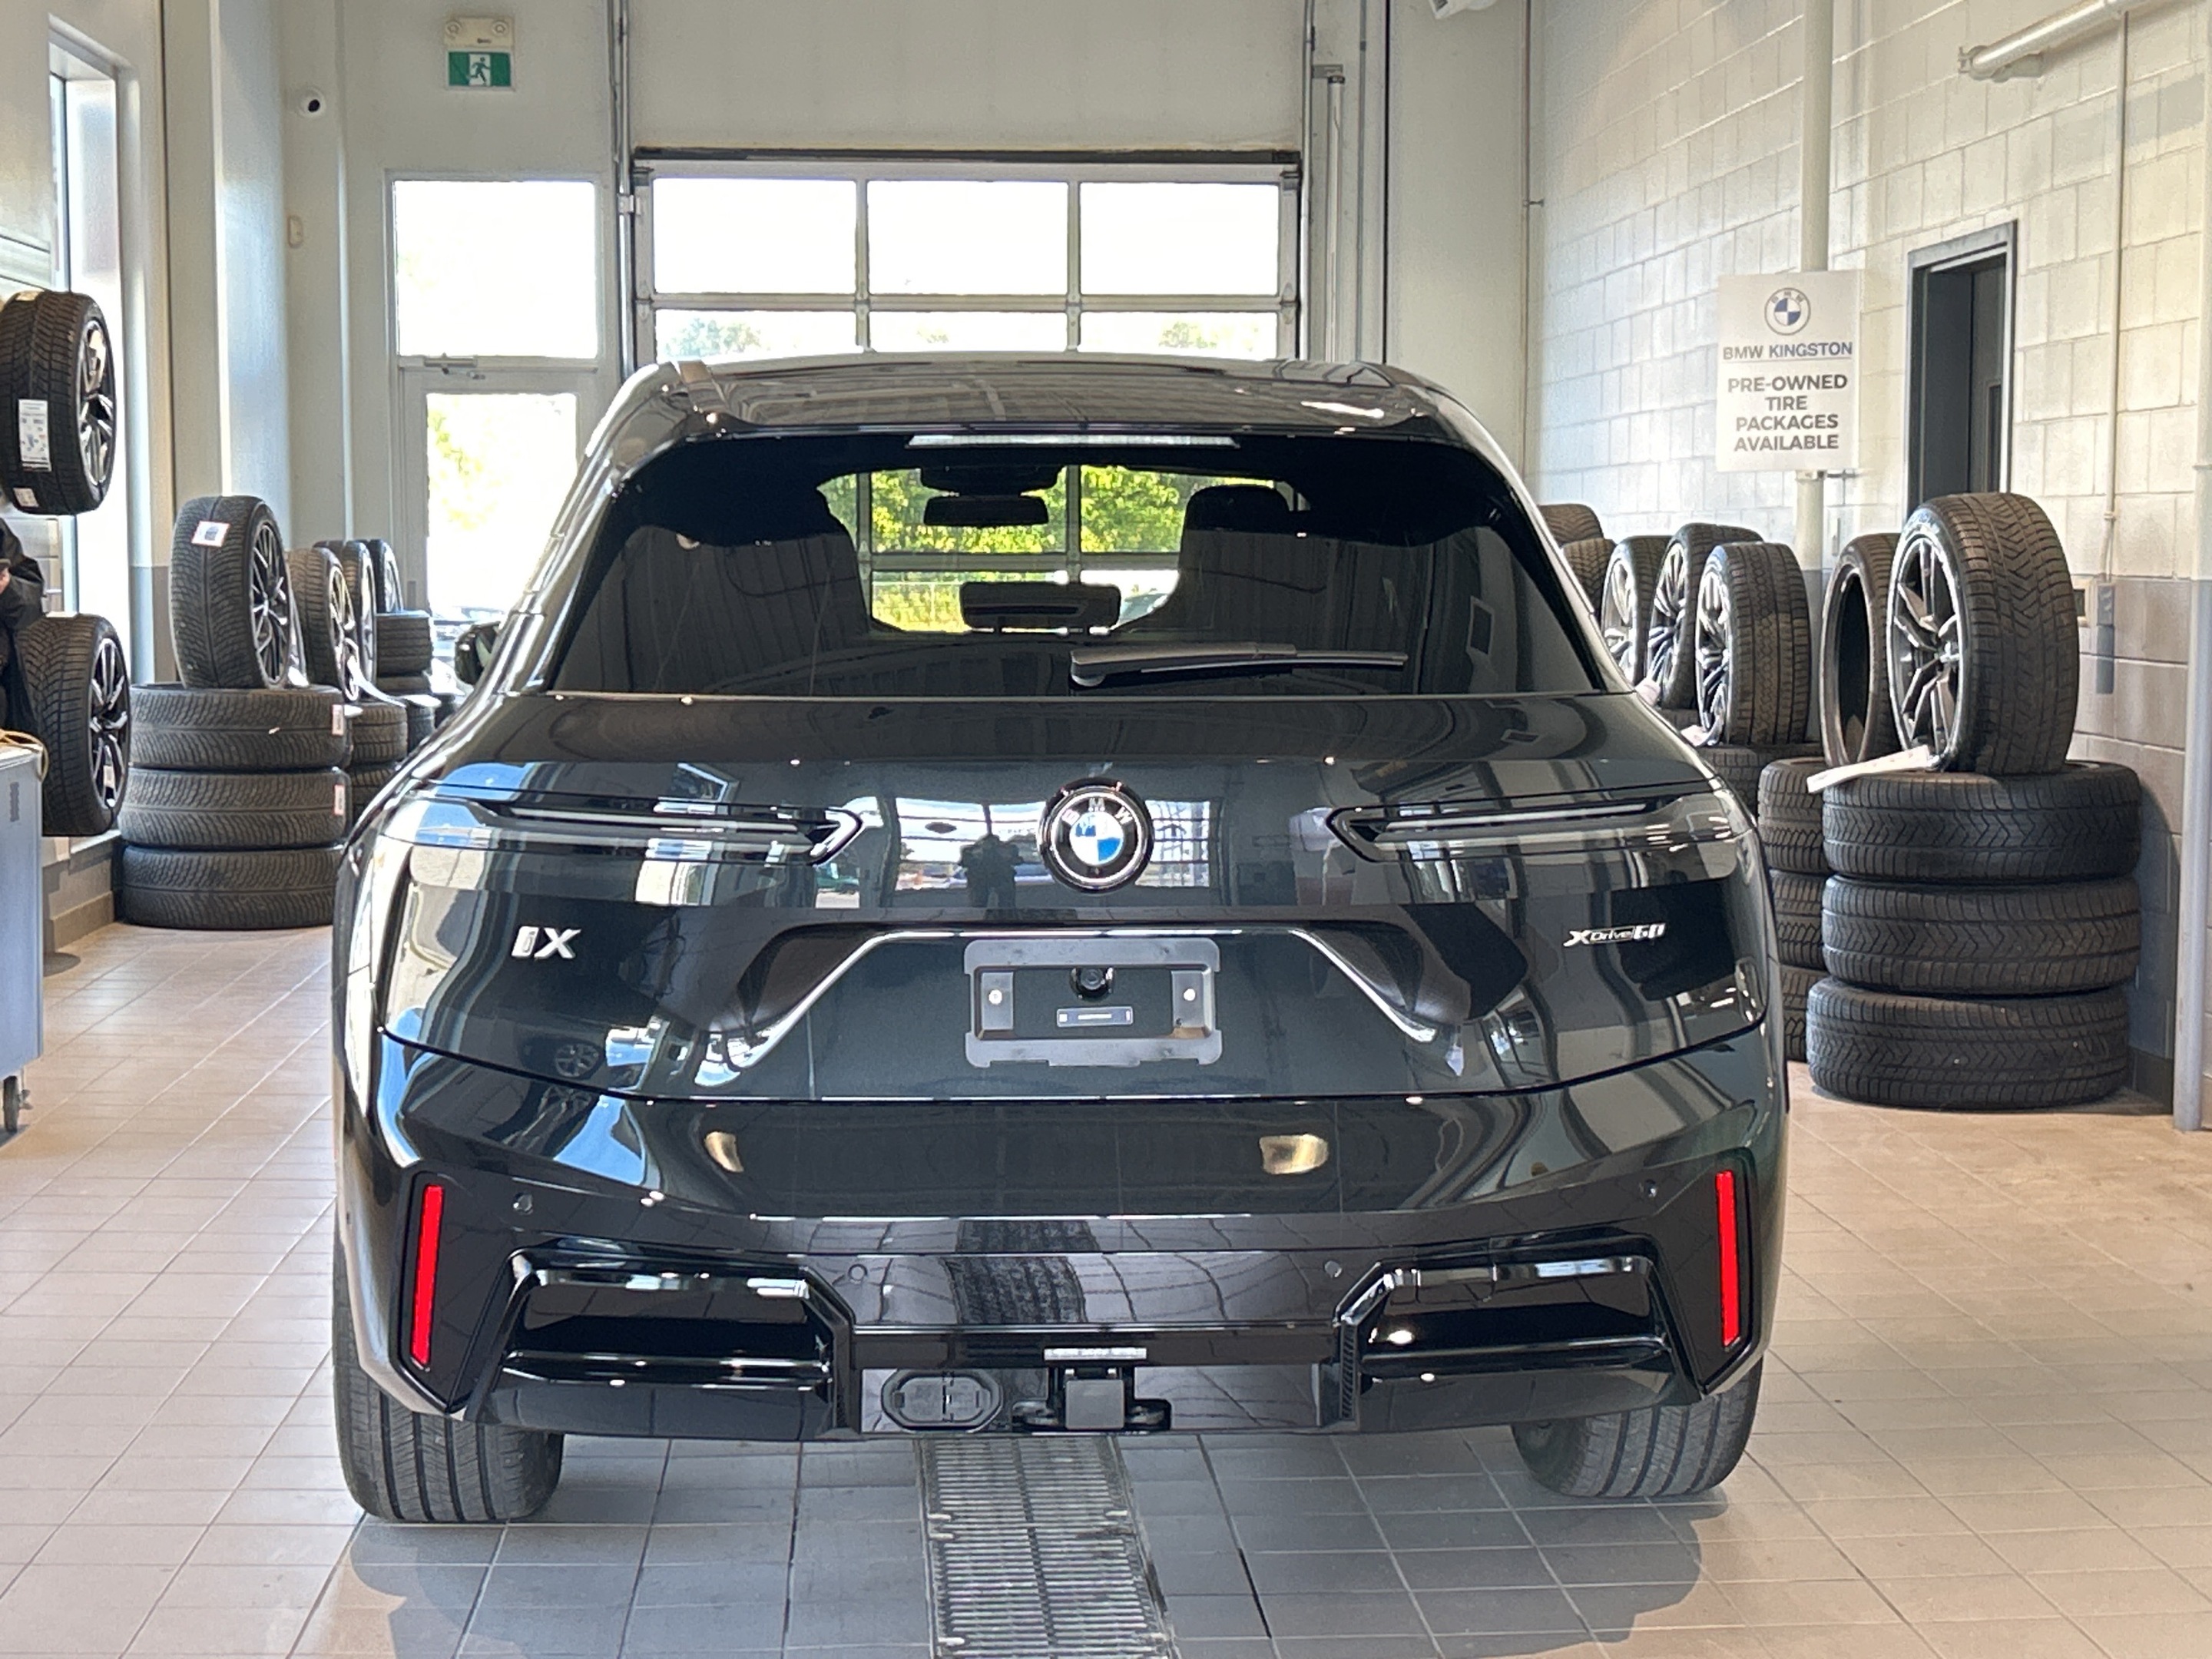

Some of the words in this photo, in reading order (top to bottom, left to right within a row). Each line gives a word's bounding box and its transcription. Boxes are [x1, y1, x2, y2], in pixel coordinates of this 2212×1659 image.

[1723, 346, 1763, 360] BMW
[1769, 342, 1853, 358] KINGSTON
[1727, 374, 1848, 392] PRE-OWNED
[1765, 396, 1808, 411] TIRE
[1736, 414, 1839, 432] PACKAGES
[1734, 435, 1839, 452] AVAILABLE
